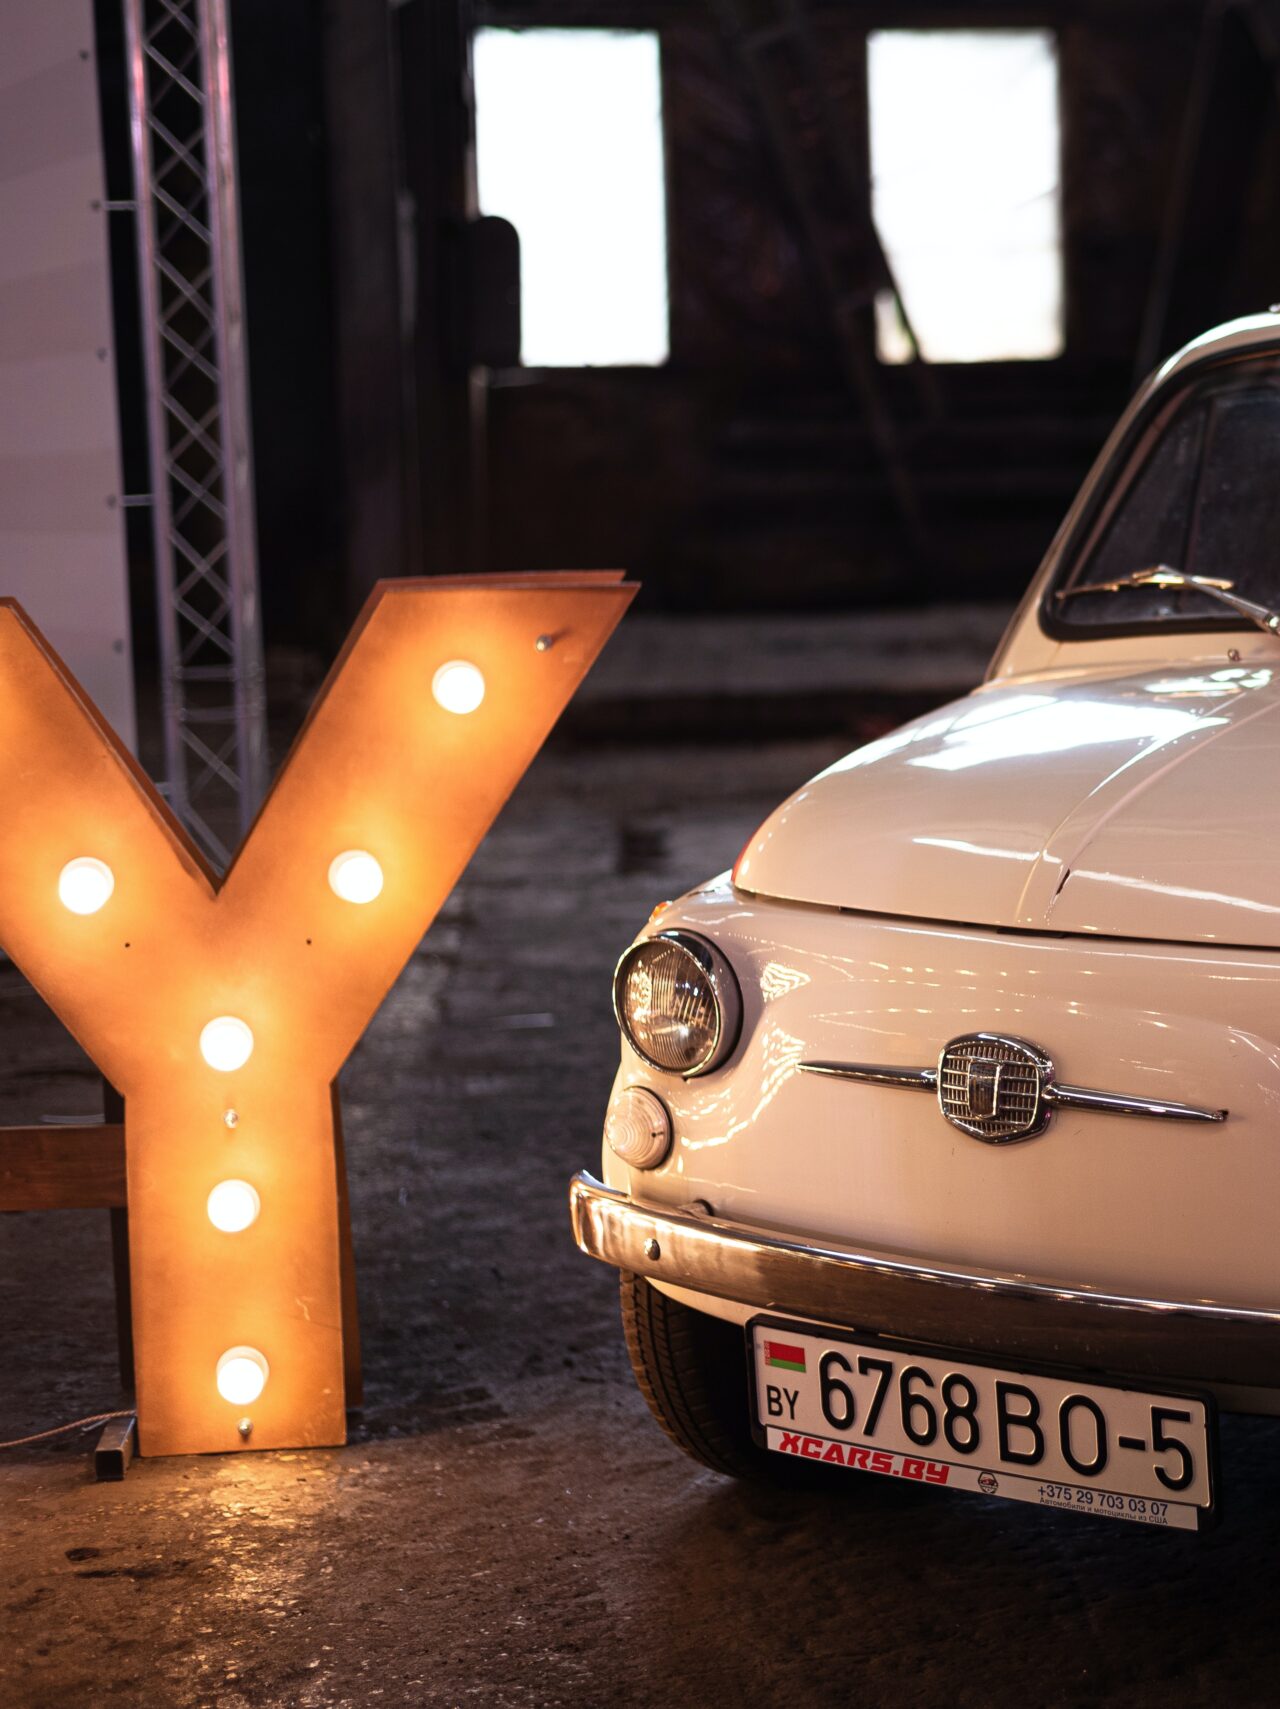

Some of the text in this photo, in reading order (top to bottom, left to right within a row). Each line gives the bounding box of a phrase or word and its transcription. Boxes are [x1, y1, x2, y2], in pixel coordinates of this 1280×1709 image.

[0, 569, 640, 1457] Y
[766, 1385, 799, 1420] BY
[779, 1431, 949, 1485] XCARS.BY
[1038, 1485, 1168, 1516] +375 29 703 03 07
[1040, 1497, 1085, 1511] Автомобили
[1149, 1515, 1168, 1524] США
